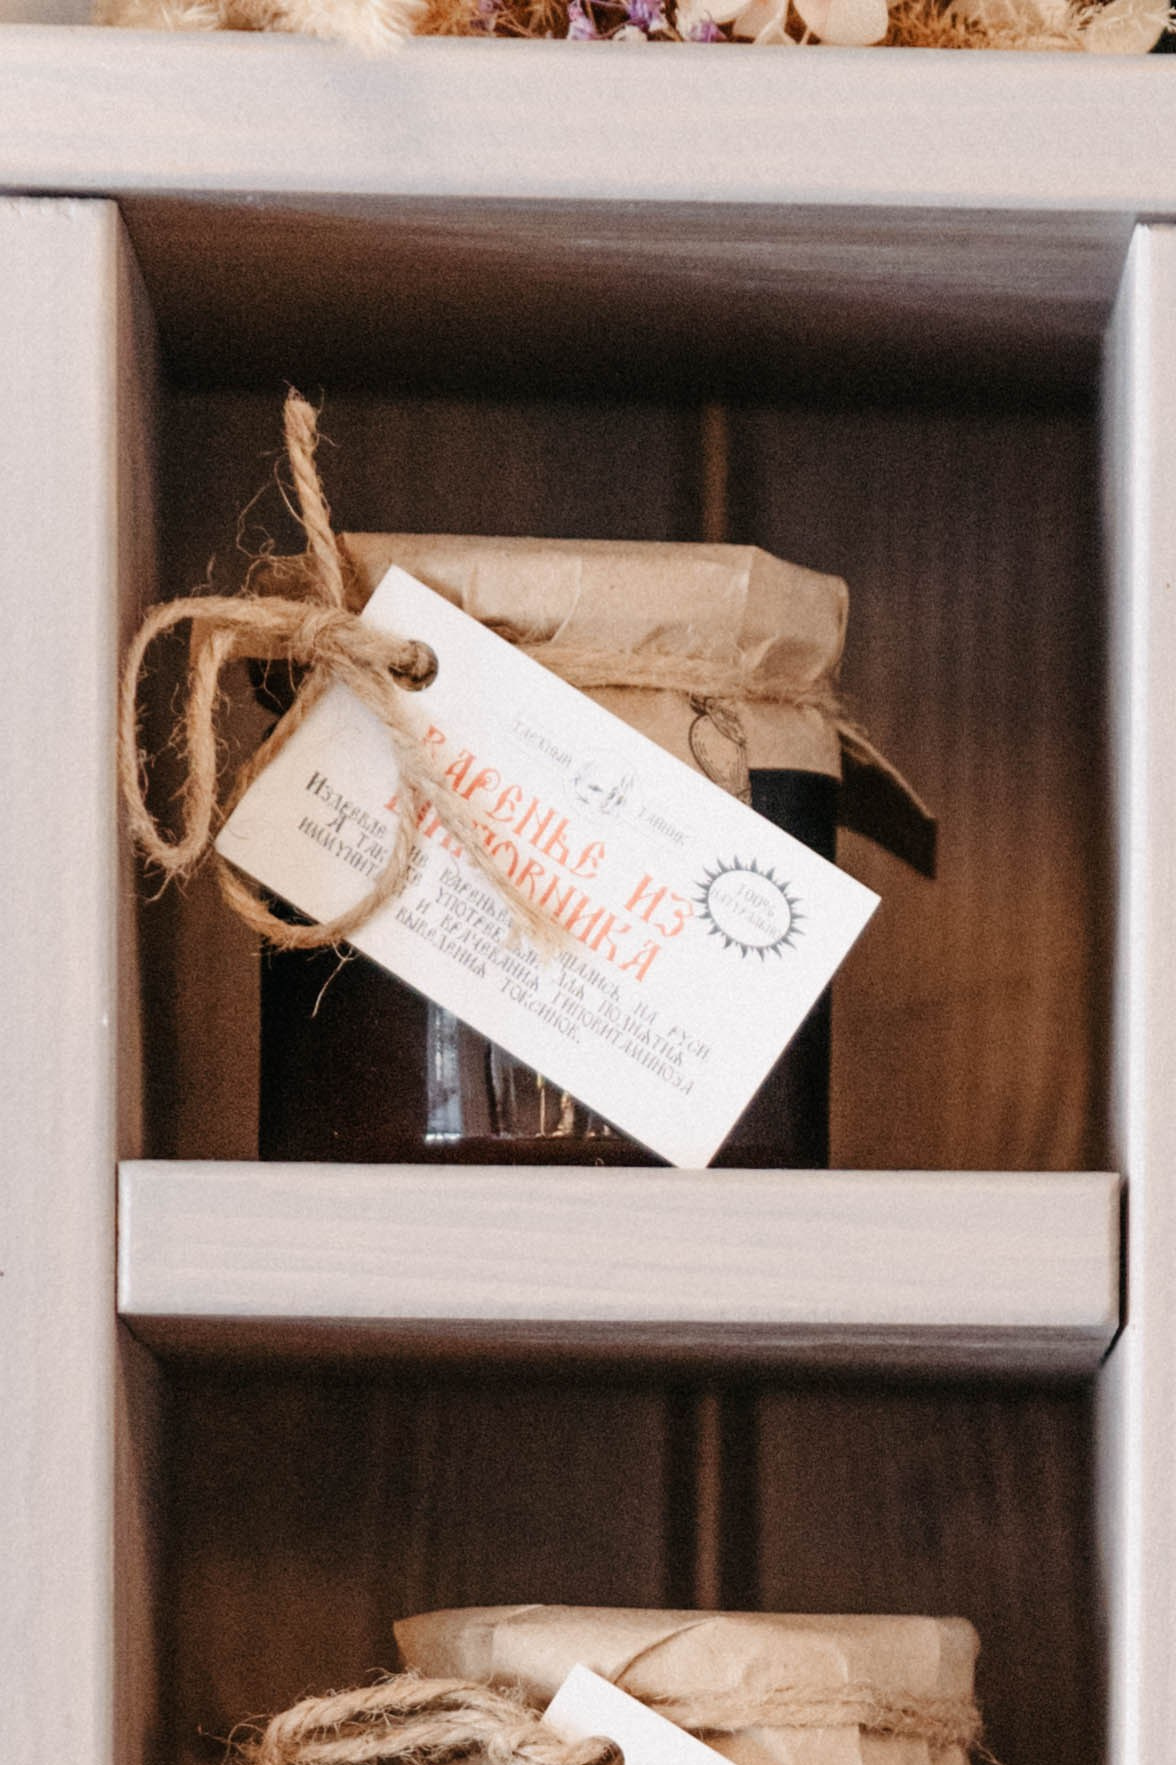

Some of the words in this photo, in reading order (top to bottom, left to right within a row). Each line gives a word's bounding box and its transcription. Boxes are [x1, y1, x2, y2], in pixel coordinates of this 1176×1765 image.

[325, 808, 349, 834] А
[551, 969, 589, 1002] ДЛЯ
[415, 898, 431, 915] И
[622, 872, 699, 944] ИЗ
[632, 1000, 660, 1026] НА
